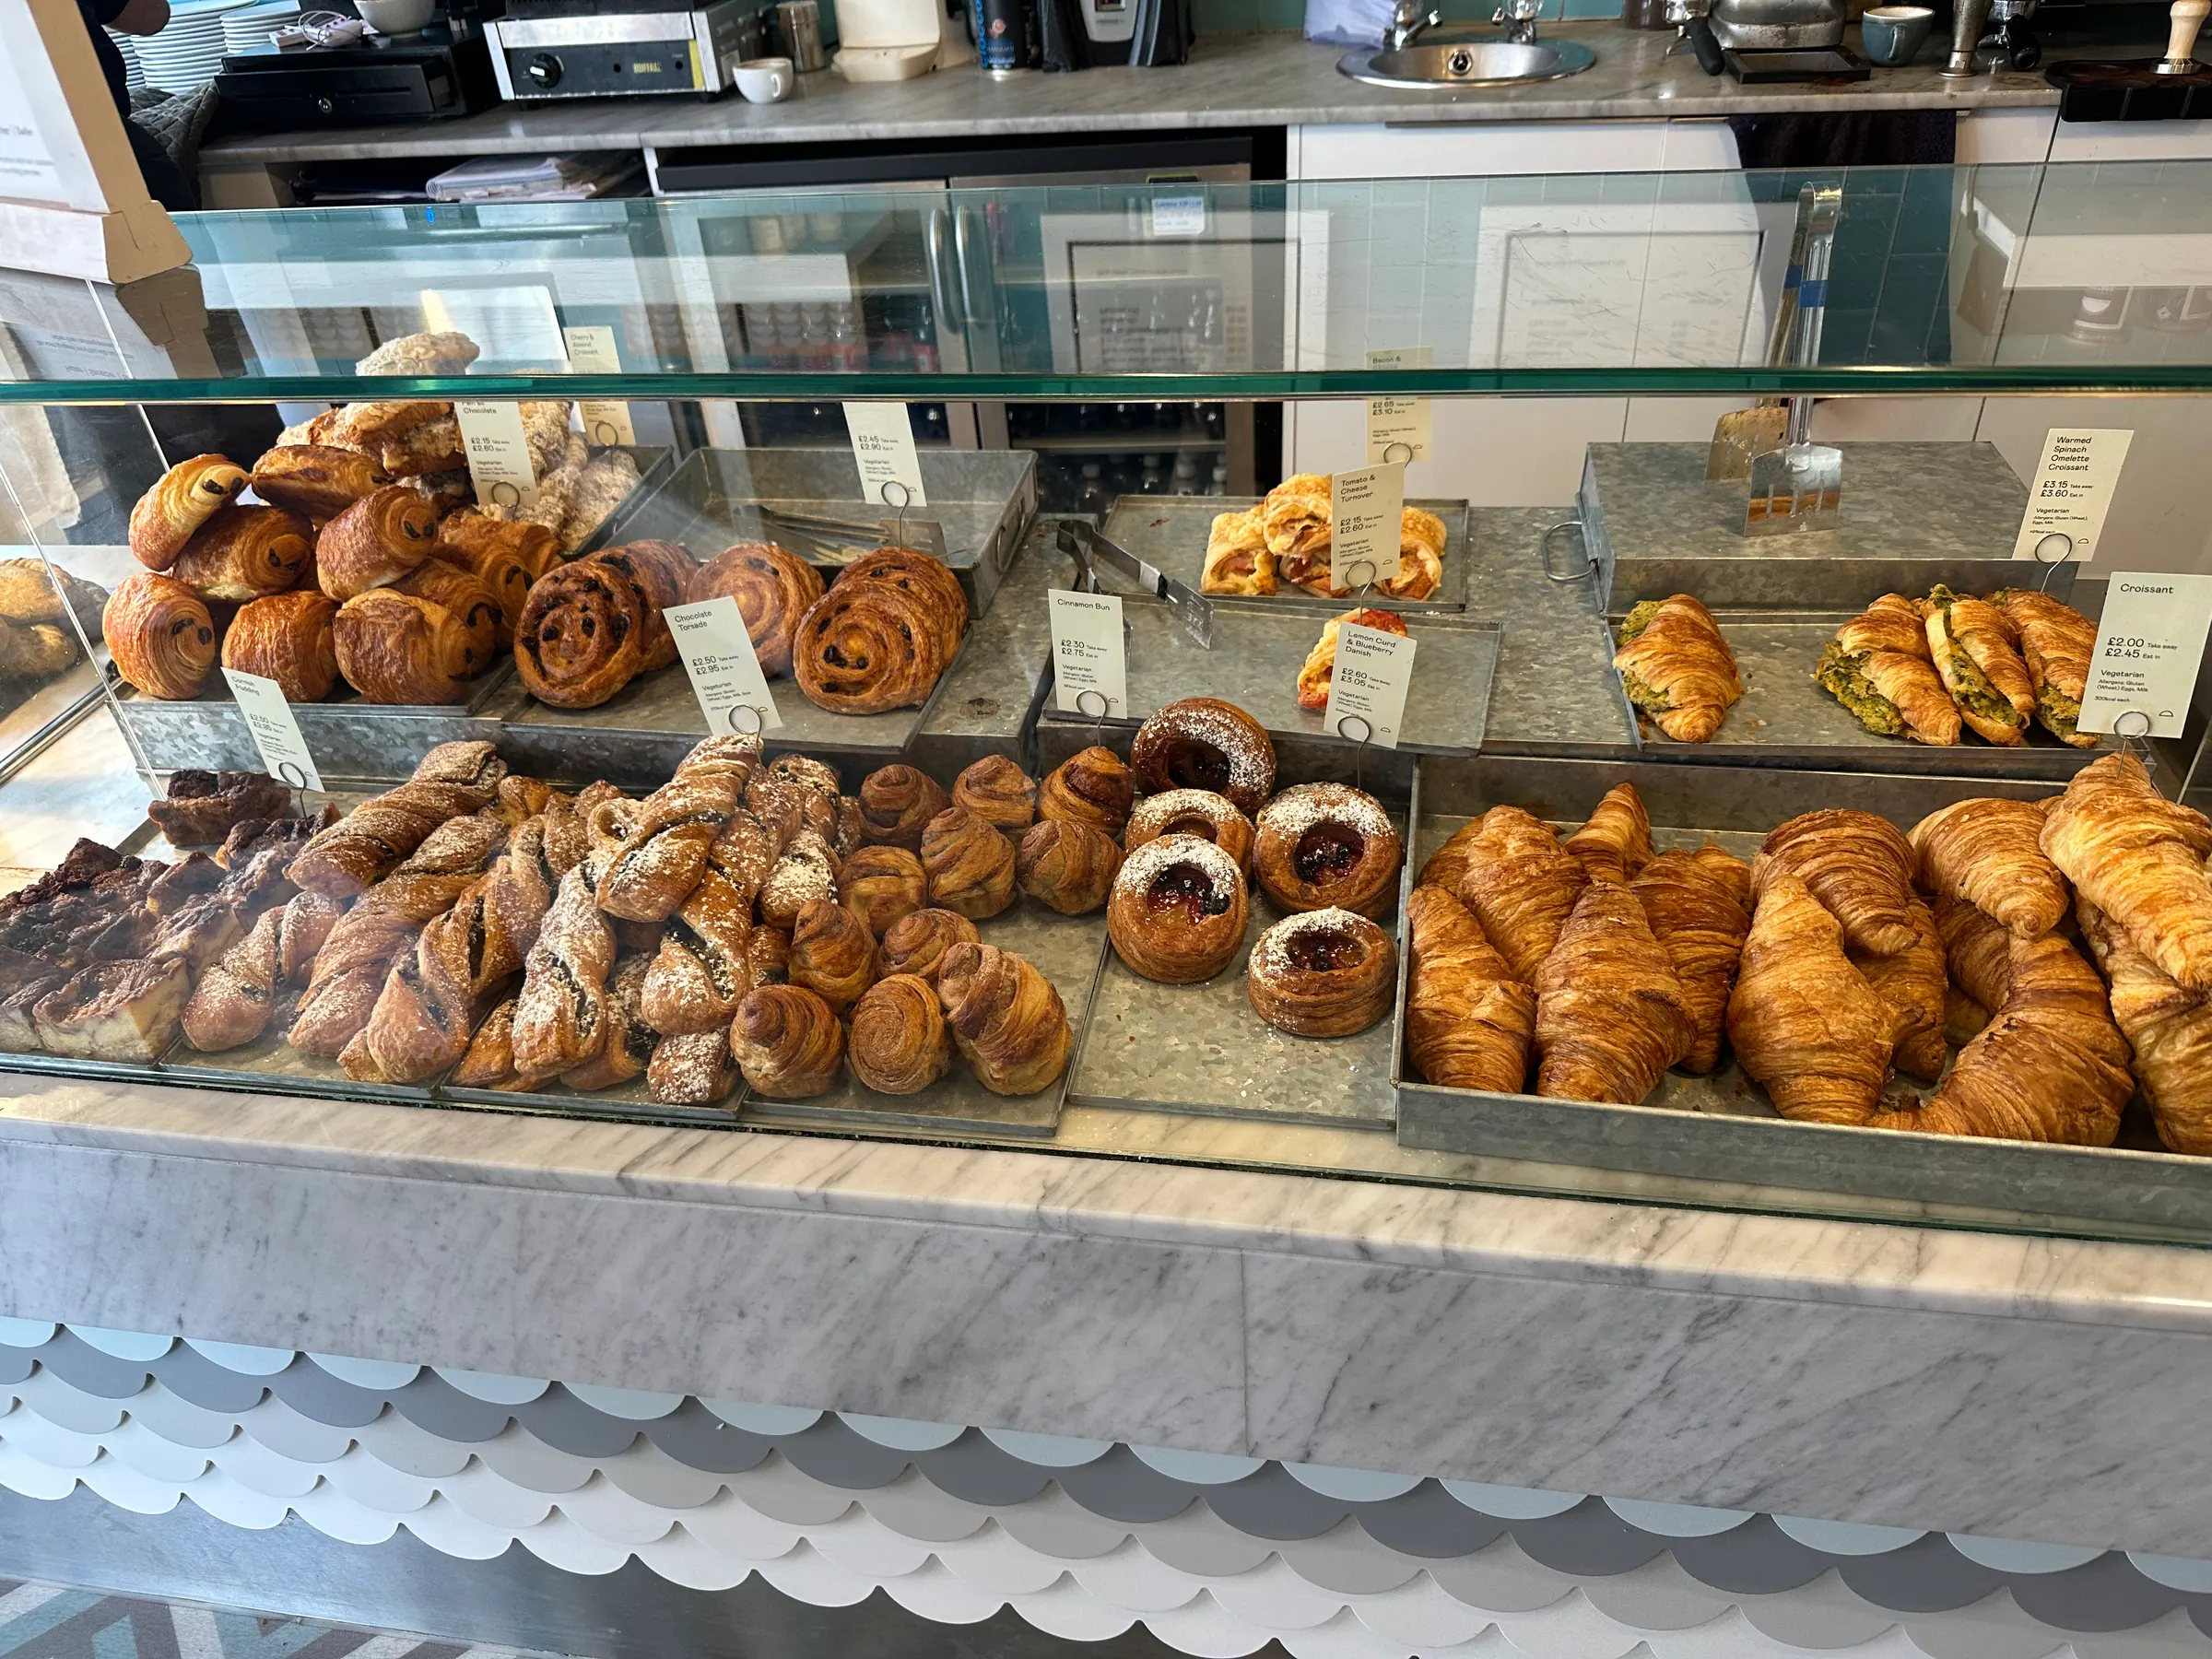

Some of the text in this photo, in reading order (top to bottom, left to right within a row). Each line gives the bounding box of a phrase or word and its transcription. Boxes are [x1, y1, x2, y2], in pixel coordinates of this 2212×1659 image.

[1341, 477, 1368, 487] Tomato
[1340, 485, 1368, 495] Cheese
[1340, 491, 1373, 503] Turnover
[1340, 516, 1361, 526] £2.15
[1340, 524, 1363, 535] £2.60
[1339, 538, 1369, 548] Vegetarian
[2121, 583, 2174, 594] Croissant
[1057, 598, 1110, 611] Cinnamon Bun
[675, 610, 712, 623] Chocolate
[677, 621, 708, 631] Torsade
[1061, 640, 1085, 648] £2.30
[1348, 630, 1396, 648] Lemon Curd
[2108, 637, 2145, 647] £2.00
[1062, 648, 1084, 656] £2.75
[1346, 646, 1371, 657] Danish
[1356, 641, 1394, 655] Blueberry
[2105, 648, 2140, 658] £2.45
[692, 655, 716, 666] £2.50
[696, 665, 720, 675] £2.95
[1062, 664, 1091, 672] Vegetarian
[1342, 667, 1367, 679] £2.60
[2100, 669, 2145, 678] Vegetarian
[702, 682, 732, 691] Vegetarian
[1341, 676, 1366, 687] £3.05
[1338, 689, 1370, 701] Vegetarian
